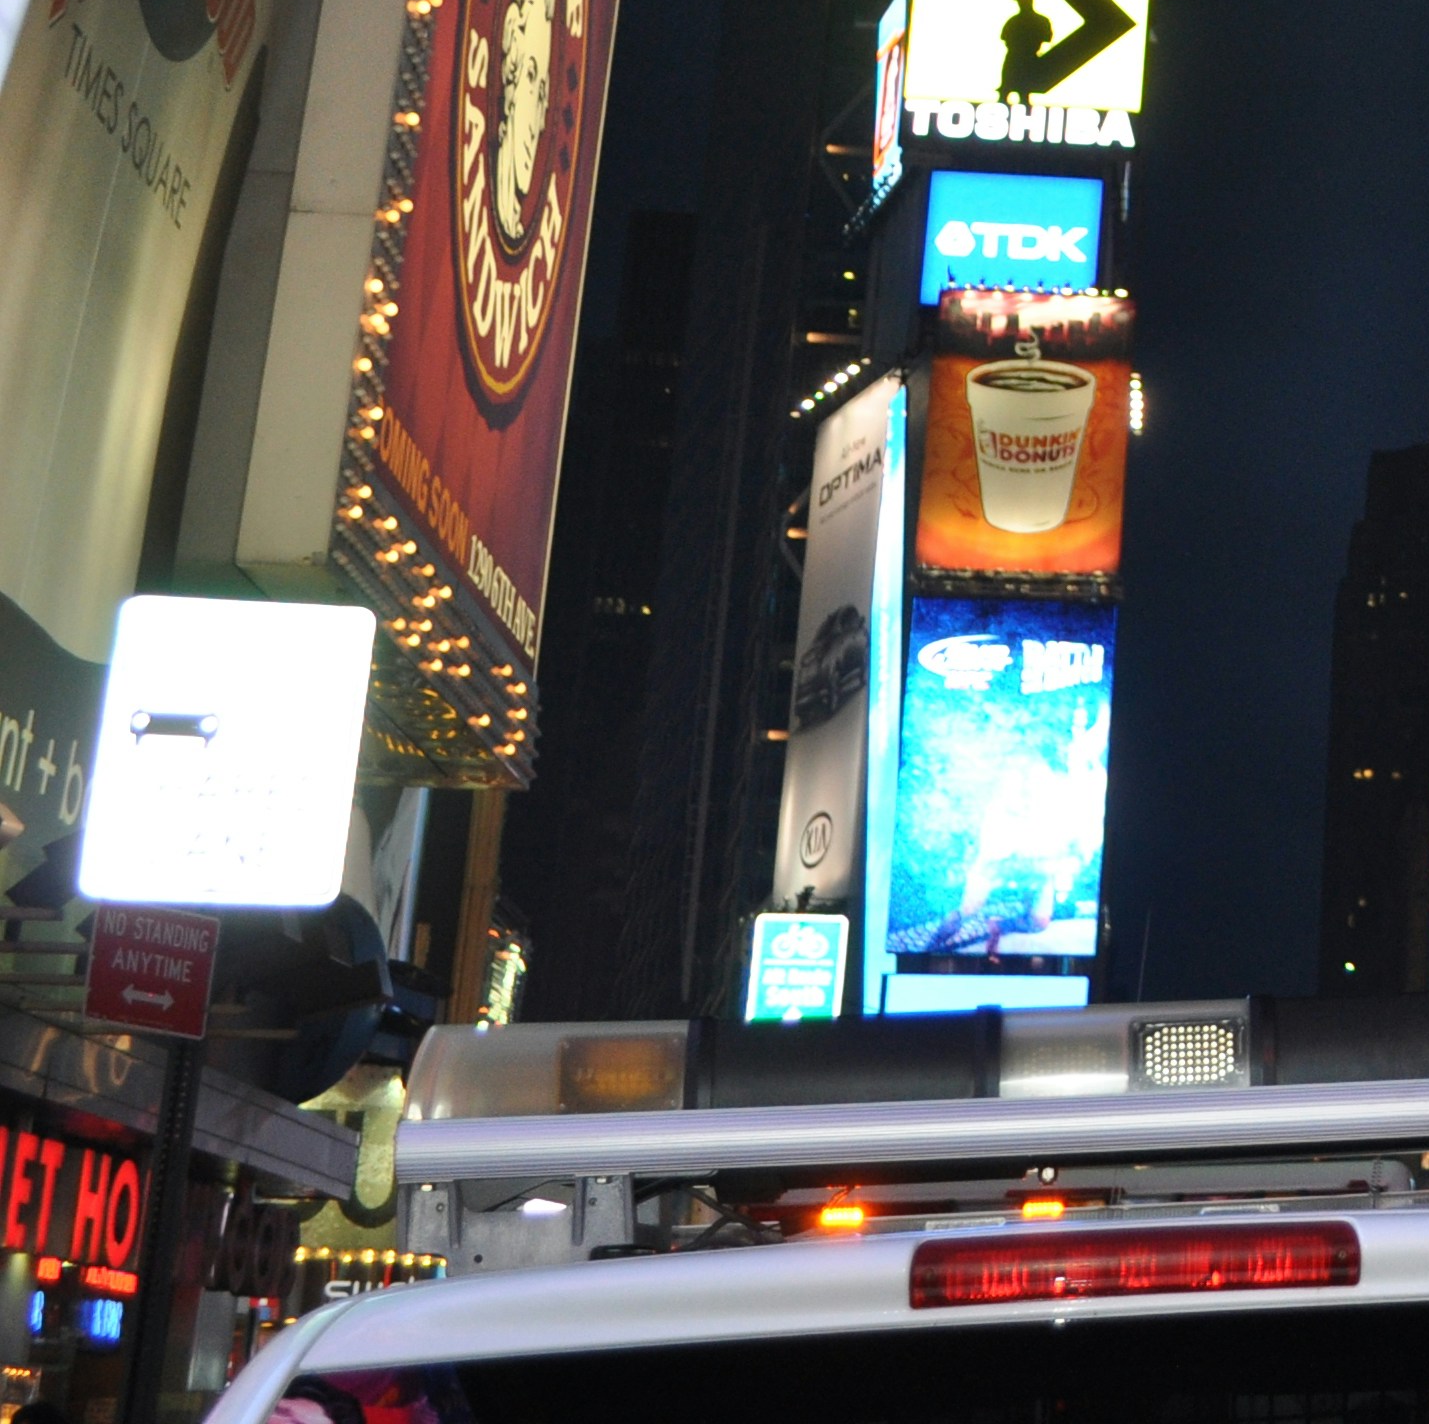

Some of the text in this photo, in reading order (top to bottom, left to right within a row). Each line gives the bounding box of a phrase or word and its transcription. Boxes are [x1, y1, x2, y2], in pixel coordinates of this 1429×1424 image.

[65, 23, 192, 230] TIMES SQUARE
[904, 98, 1136, 148] TOSHIBA
[460, 28, 564, 369] SANDWICH
[970, 221, 1088, 264] TDK
[376, 401, 430, 514] OMING
[428, 475, 469, 566] SOON
[819, 446, 883, 507] OPTIMA
[0, 709, 35, 792] nt
[103, 908, 210, 953] NO STANDING
[111, 946, 194, 983] ANYTIME
[0, 1128, 65, 1253] ET
